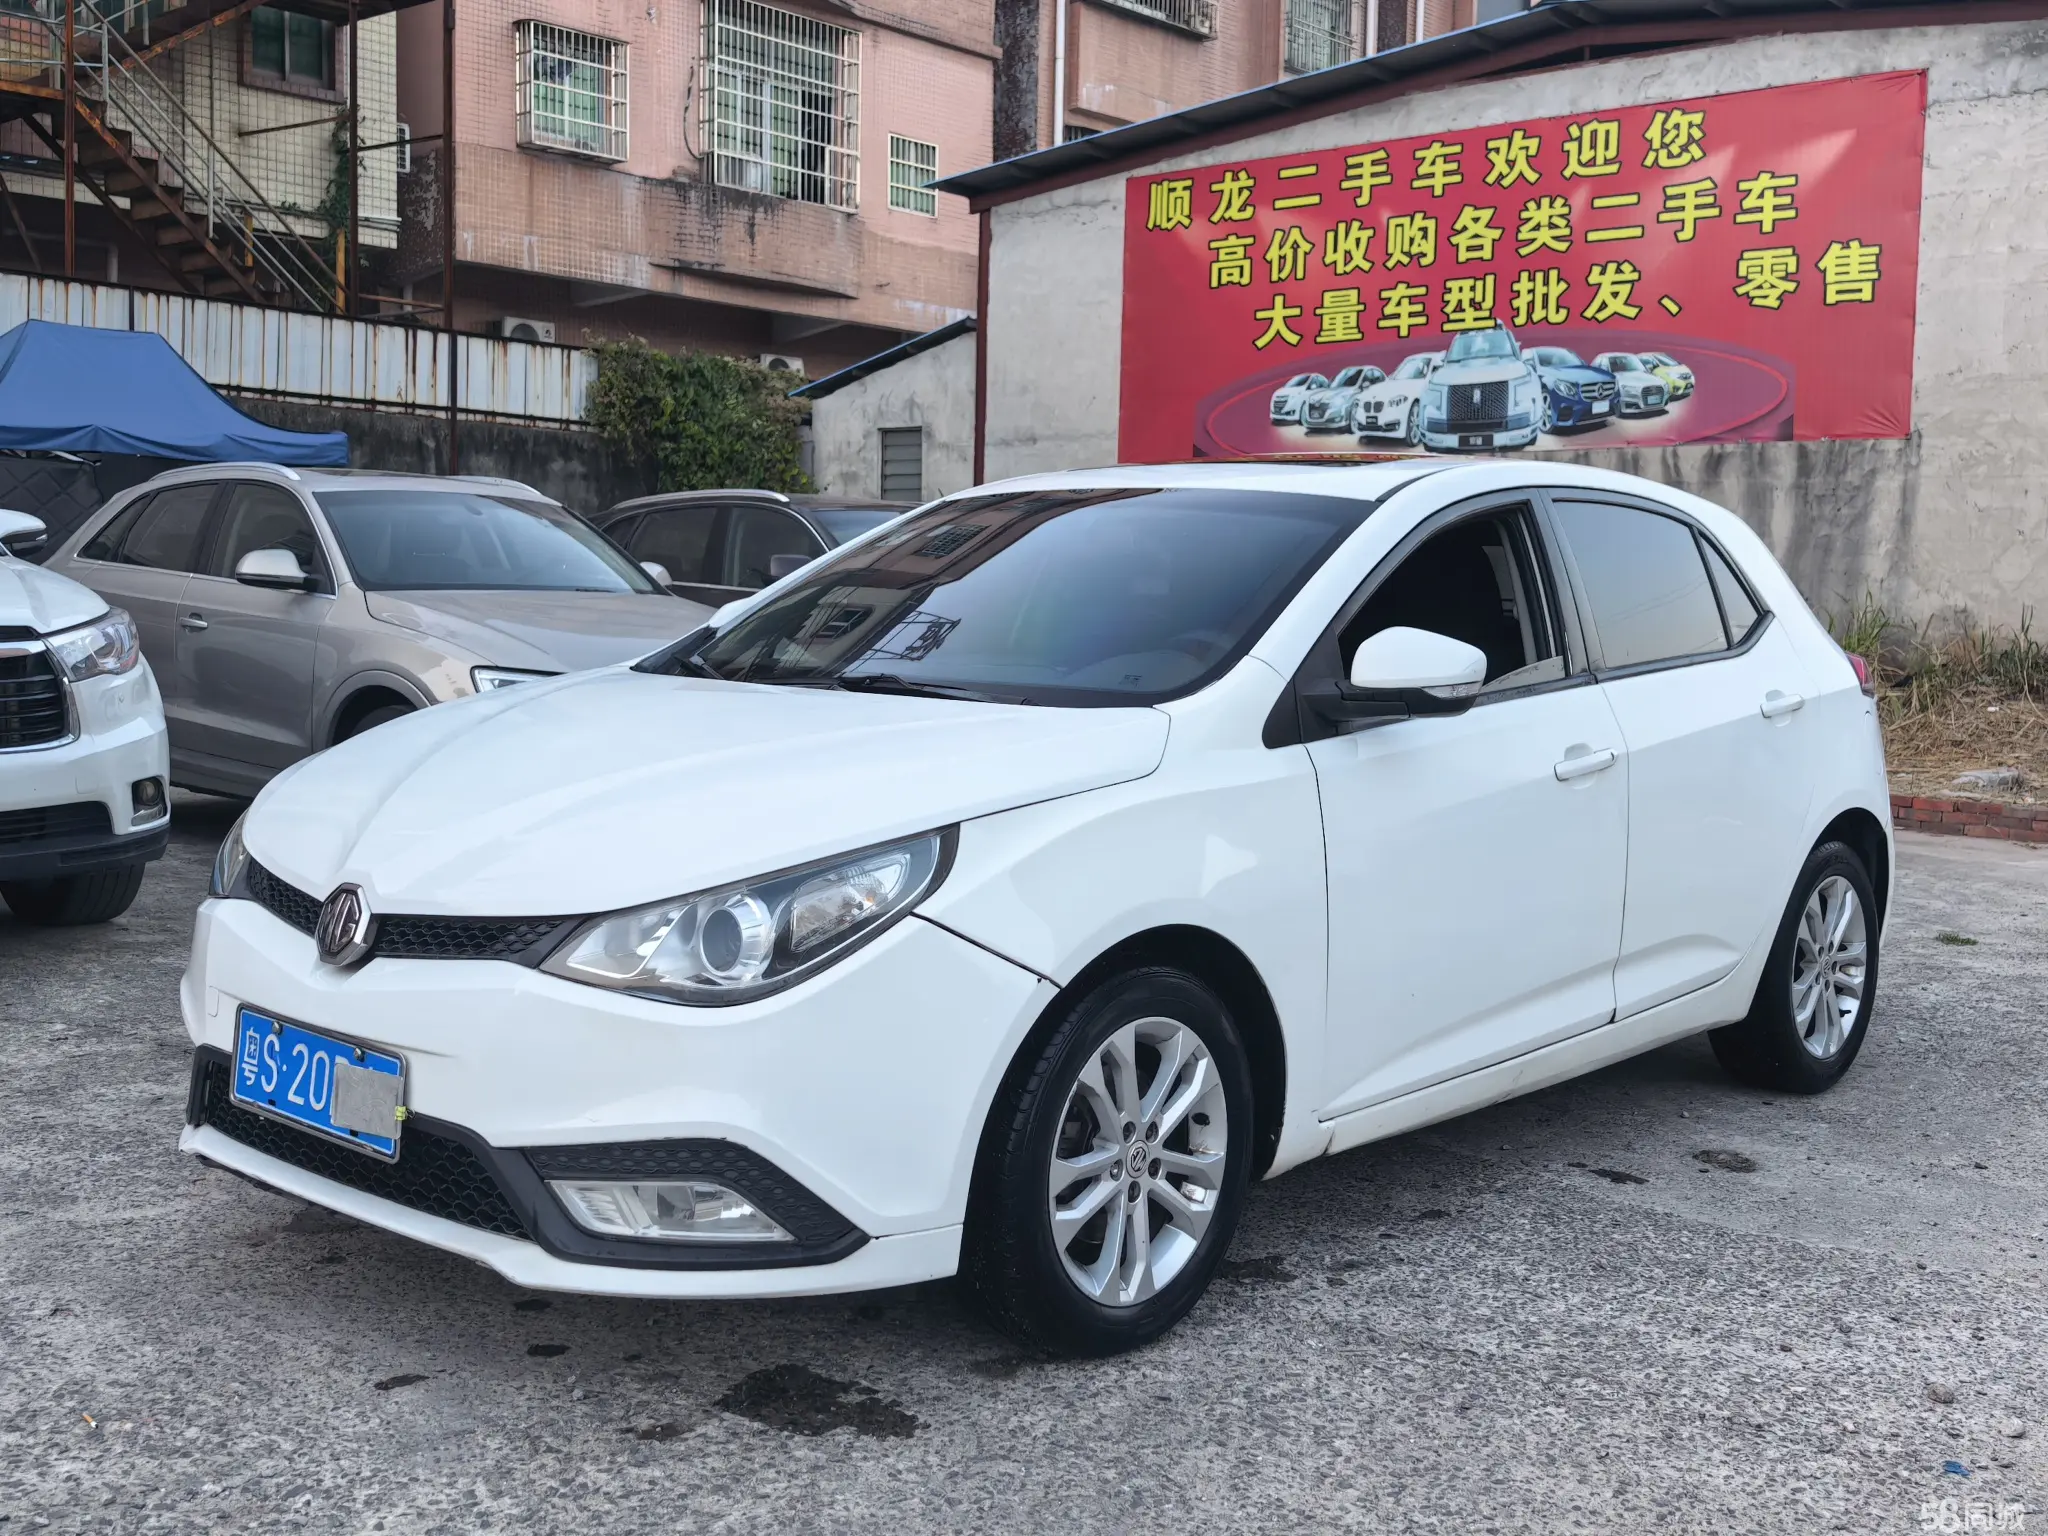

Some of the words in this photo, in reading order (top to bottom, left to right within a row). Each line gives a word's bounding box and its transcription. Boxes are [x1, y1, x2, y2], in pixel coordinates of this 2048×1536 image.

[1146, 107, 1708, 231] 顺龙二手车欢迎您
[1207, 171, 1798, 289] 高价收购各类二手车
